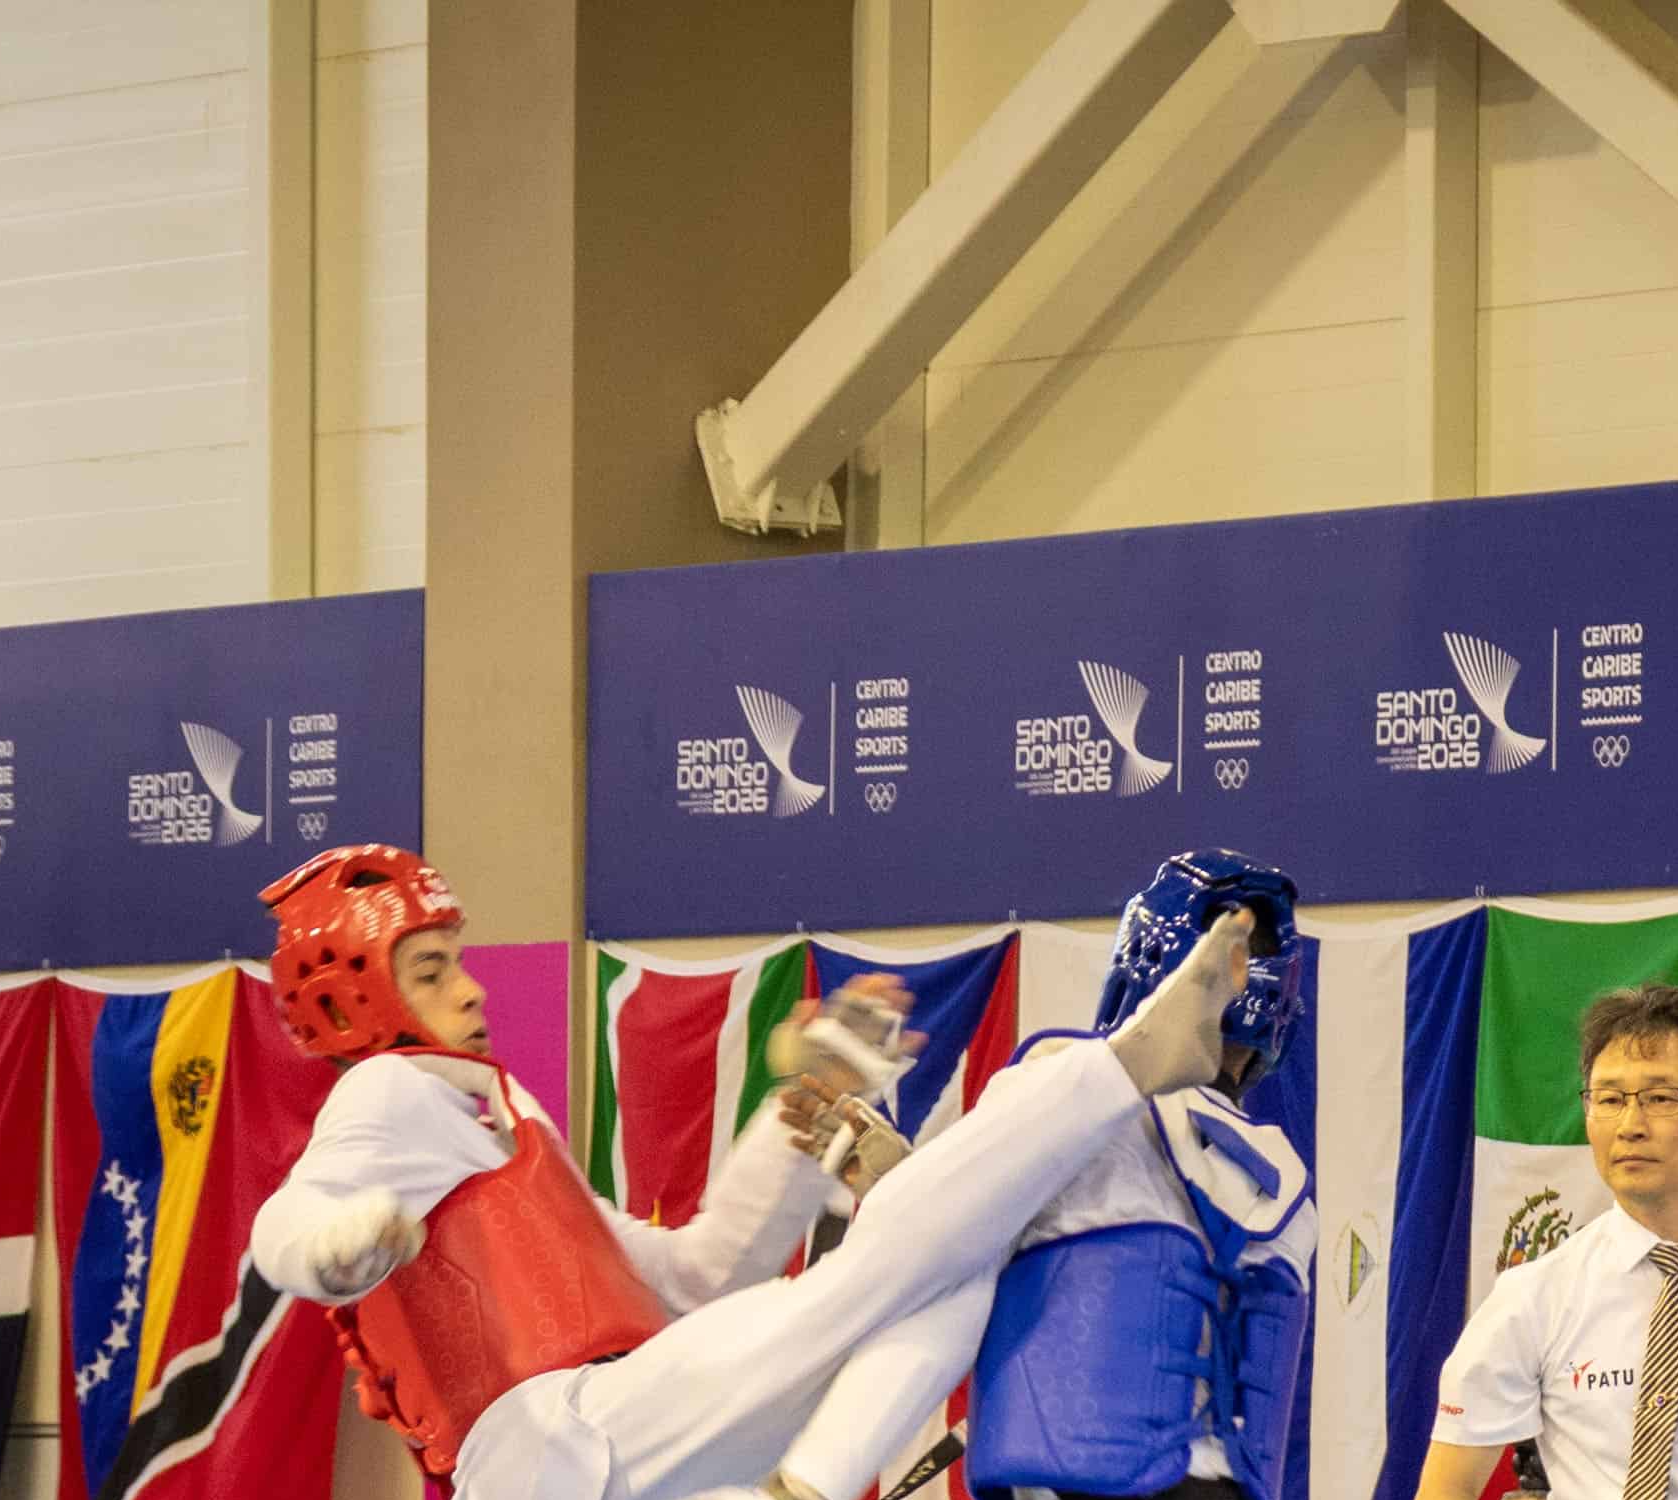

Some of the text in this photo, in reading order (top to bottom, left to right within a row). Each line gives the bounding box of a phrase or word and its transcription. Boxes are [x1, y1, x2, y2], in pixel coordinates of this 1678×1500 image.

[1582, 623, 1643, 647] CENTRO
[1206, 650, 1262, 673] CENTRO
[1582, 653, 1642, 679] CARIBE
[856, 678, 908, 699] CENTRO
[1205, 679, 1261, 704] CARIBE
[1581, 685, 1642, 709] SPORTS
[1377, 688, 1456, 718] SANTO
[289, 713, 337, 734] CENTRO
[856, 706, 908, 729] CARIBE
[1016, 715, 1090, 744] SANTO
[1205, 710, 1260, 733] SPORTS
[1376, 714, 1480, 746] DOMINGO
[289, 740, 337, 762] CARIBE
[677, 738, 747, 765] SANTO
[855, 735, 908, 757] SPORTS
[1016, 739, 1112, 771] DOMINGO
[1418, 742, 1480, 770] 2026
[129, 771, 193, 797] SANTO
[289, 768, 337, 788] SPORTS
[677, 761, 768, 790] DOMINGO
[1054, 766, 1112, 794] 2026
[129, 794, 212, 822] DOMINGO
[713, 787, 768, 813] 2026
[162, 818, 212, 843] 2026
[1587, 1368, 1634, 1390] PATU
